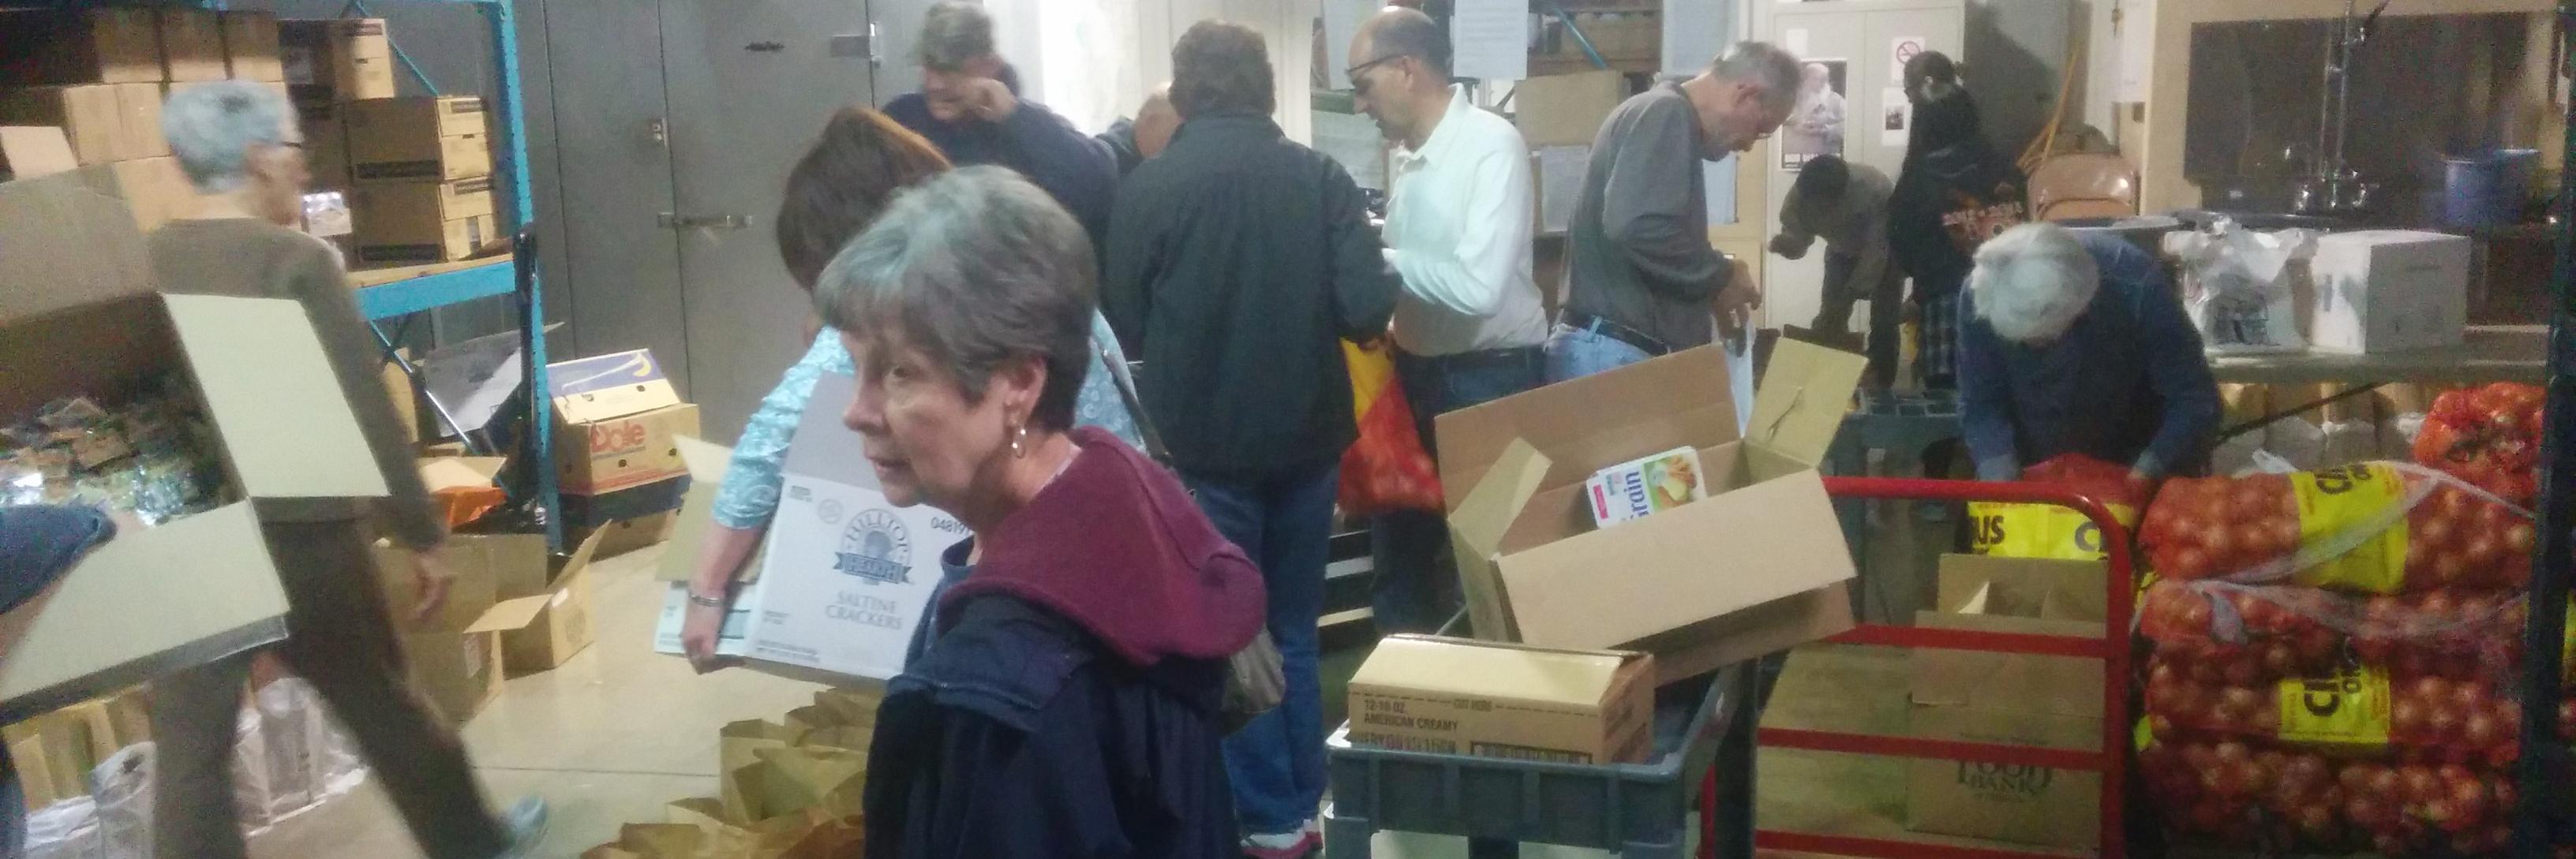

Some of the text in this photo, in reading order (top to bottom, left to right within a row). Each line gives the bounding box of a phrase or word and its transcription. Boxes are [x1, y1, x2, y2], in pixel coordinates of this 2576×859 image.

[590, 420, 646, 453] Dole
[838, 591, 897, 614] SALTINE
[826, 604, 903, 629] CRACKERS
[1364, 712, 1458, 731] AMERICAN CREAMY
